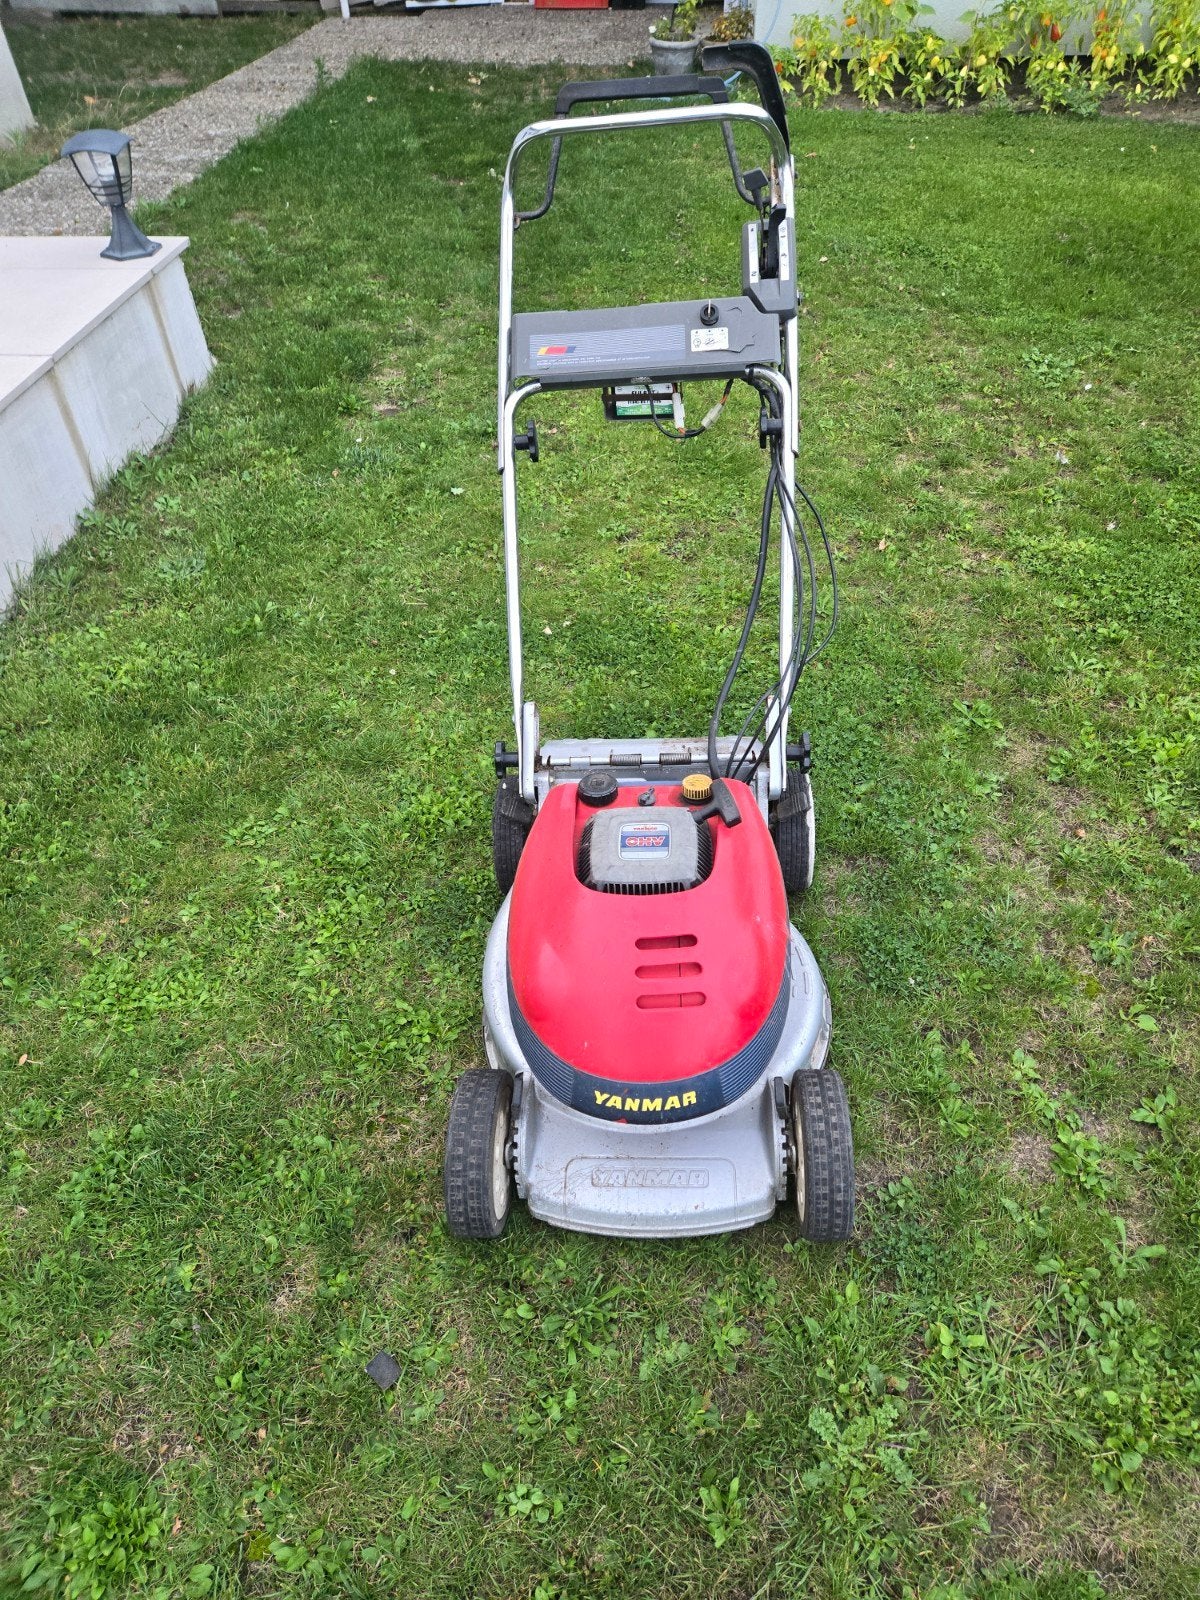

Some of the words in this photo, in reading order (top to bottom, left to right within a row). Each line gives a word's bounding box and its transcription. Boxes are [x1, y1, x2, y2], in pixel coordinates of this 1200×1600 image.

[626, 836, 665, 847] OHV
[594, 1090, 697, 1112] YANMAR
[594, 1168, 706, 1186] YANMAR
